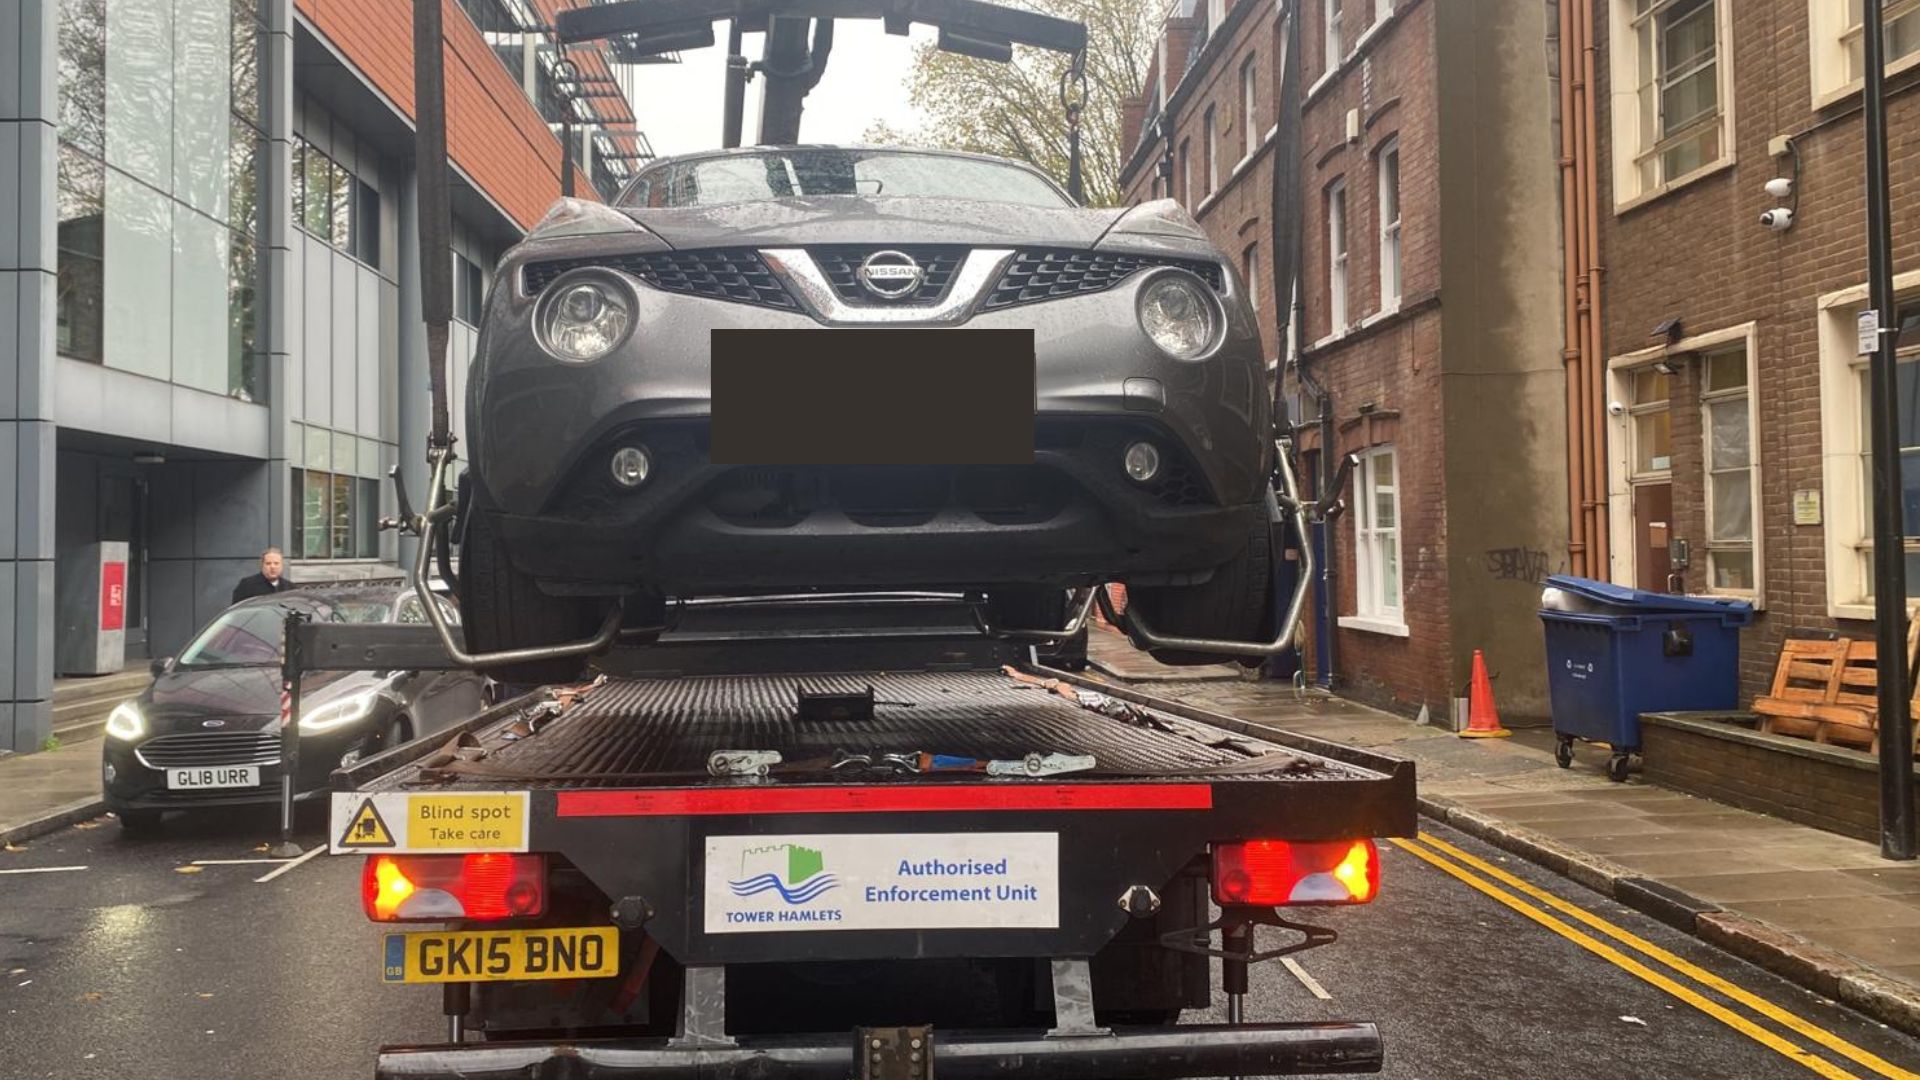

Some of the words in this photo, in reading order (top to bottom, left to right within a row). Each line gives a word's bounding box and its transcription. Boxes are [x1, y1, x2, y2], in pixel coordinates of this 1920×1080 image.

[864, 267, 917, 276] NISSAN
[177, 769, 213, 786] GL18
[217, 768, 249, 784] URR
[420, 805, 464, 819] Blind
[471, 805, 511, 822] spot
[430, 827, 464, 840] Take
[469, 829, 501, 839] care
[898, 858, 1007, 876] Authorised
[865, 886, 993, 902] Enforcement
[997, 885, 1038, 901] Unit
[726, 911, 774, 923] TOWER
[778, 909, 842, 922] HAMLETS
[419, 937, 511, 976] GK15
[524, 934, 604, 974] BNO
[386, 966, 403, 976] GB
